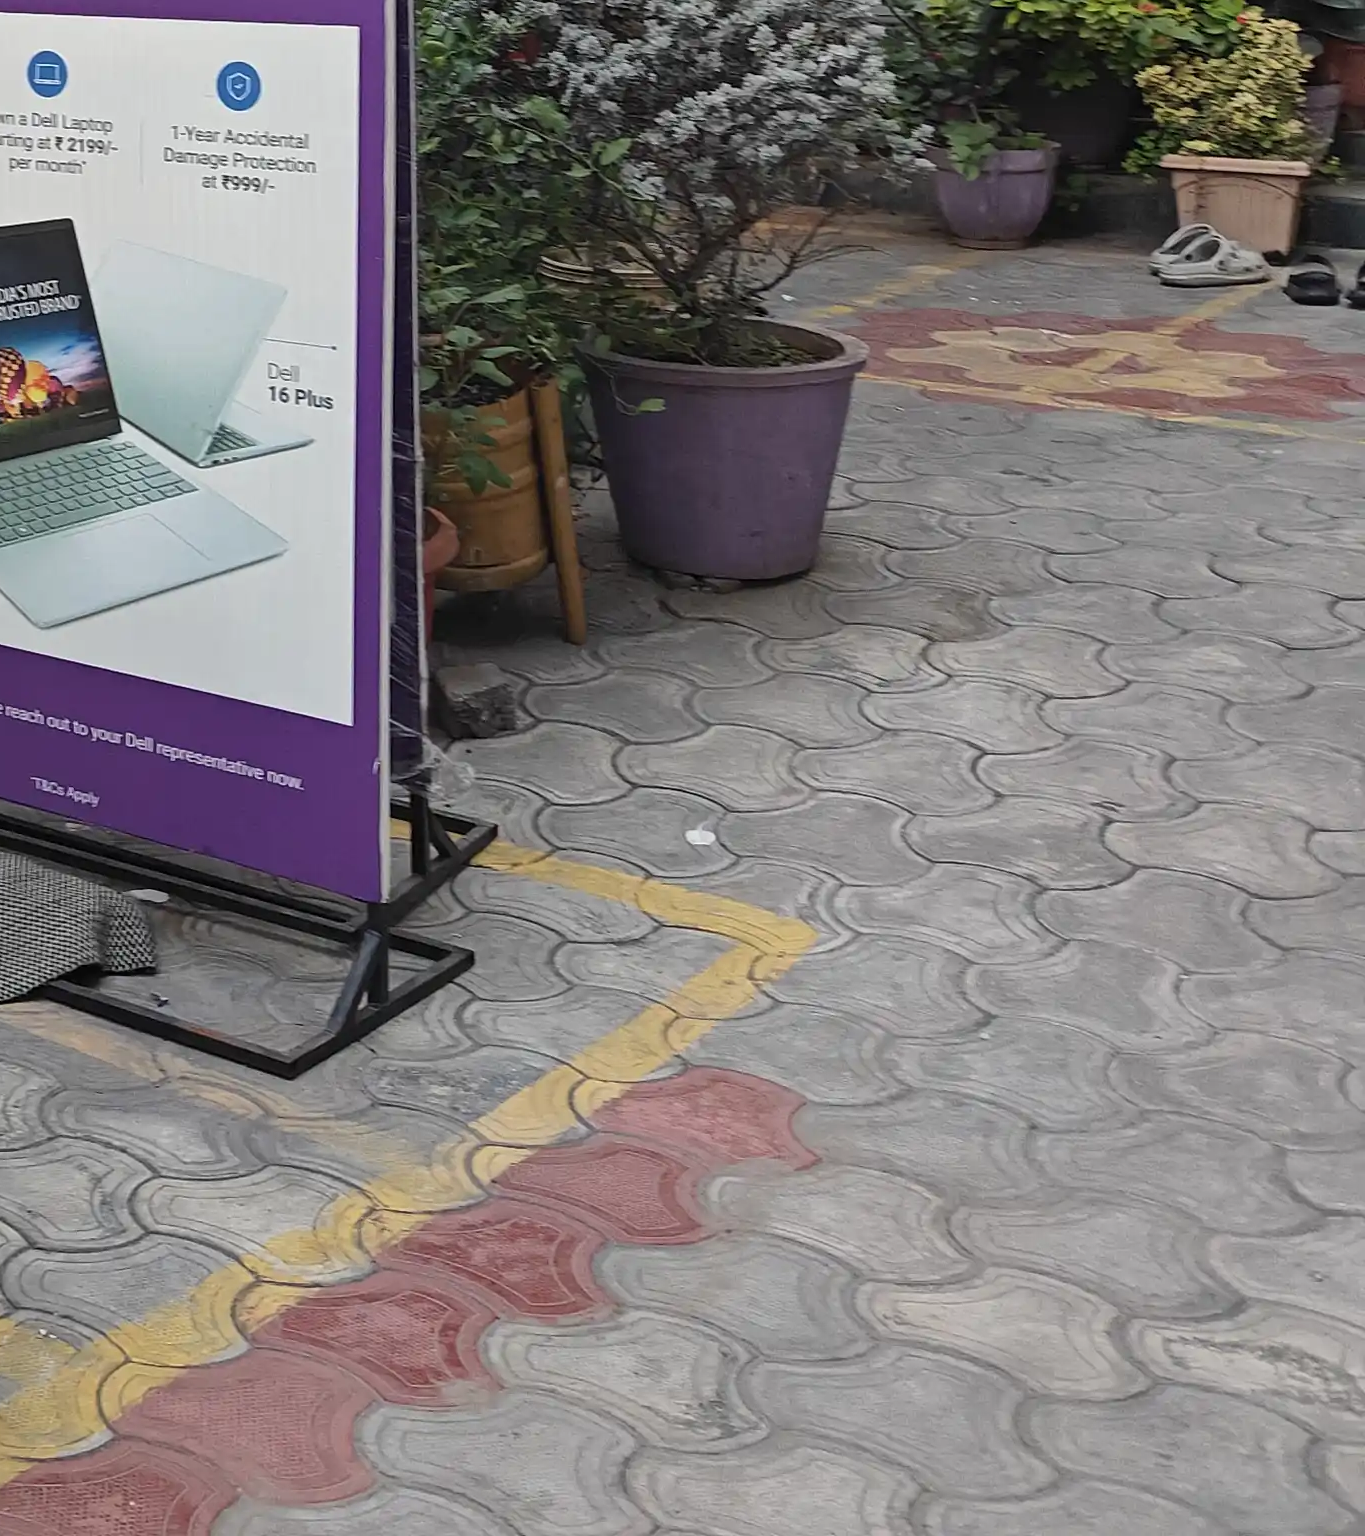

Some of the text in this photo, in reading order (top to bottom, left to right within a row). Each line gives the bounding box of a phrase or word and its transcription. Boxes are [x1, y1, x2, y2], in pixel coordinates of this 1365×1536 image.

[18, 114, 27, 126] a
[31, 112, 57, 128] Dell
[62, 114, 113, 135] Laptop
[37, 135, 51, 150] at
[171, 125, 310, 150] 1-Year Accidental
[9, 156, 32, 171] per
[163, 146, 317, 173] Damage Protection
[202, 175, 218, 189] at
[27, 279, 60, 297] MOST
[267, 361, 300, 383] Dell
[268, 385, 334, 411] 16 Plus
[4, 705, 44, 725] reach
[46, 714, 71, 732] out
[72, 720, 89, 736] to
[90, 726, 123, 744] your
[125, 732, 154, 753] Dell
[156, 742, 265, 780] representative
[267, 770, 305, 791] now.
[65, 786, 100, 808] Apply
